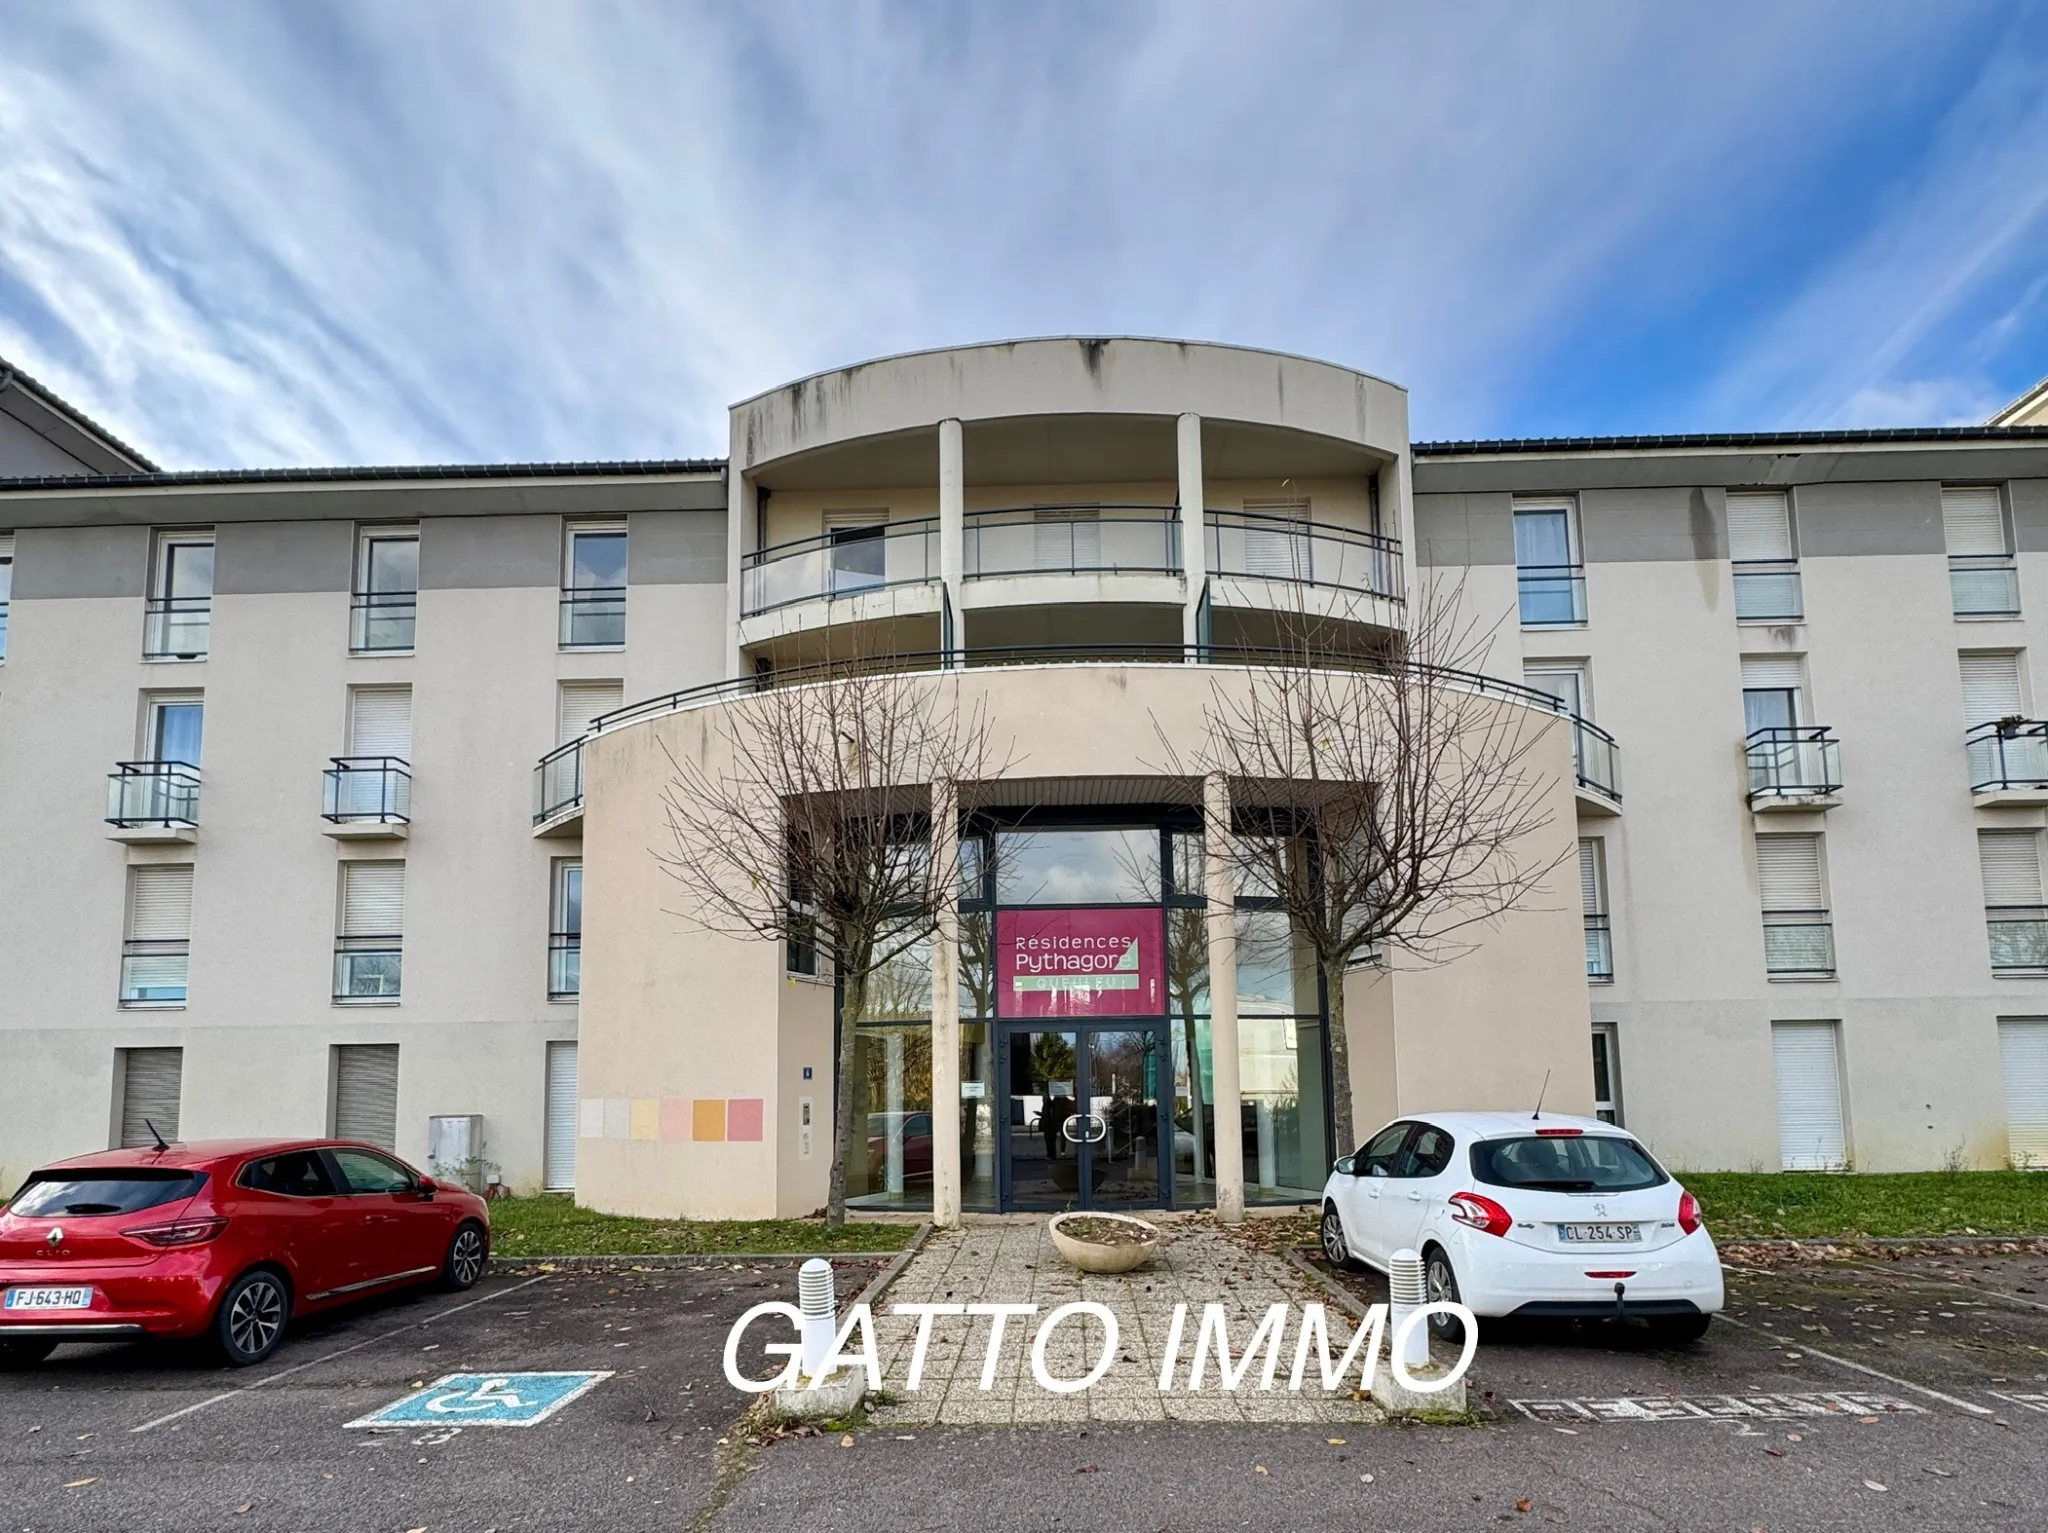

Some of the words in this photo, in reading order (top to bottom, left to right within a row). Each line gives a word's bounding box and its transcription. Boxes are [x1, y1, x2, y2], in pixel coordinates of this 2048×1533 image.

[1016, 935, 1131, 950] Résidences
[1016, 953, 1132, 972] Pythagore
[16, 1290, 82, 1306] FJ-643-HQ
